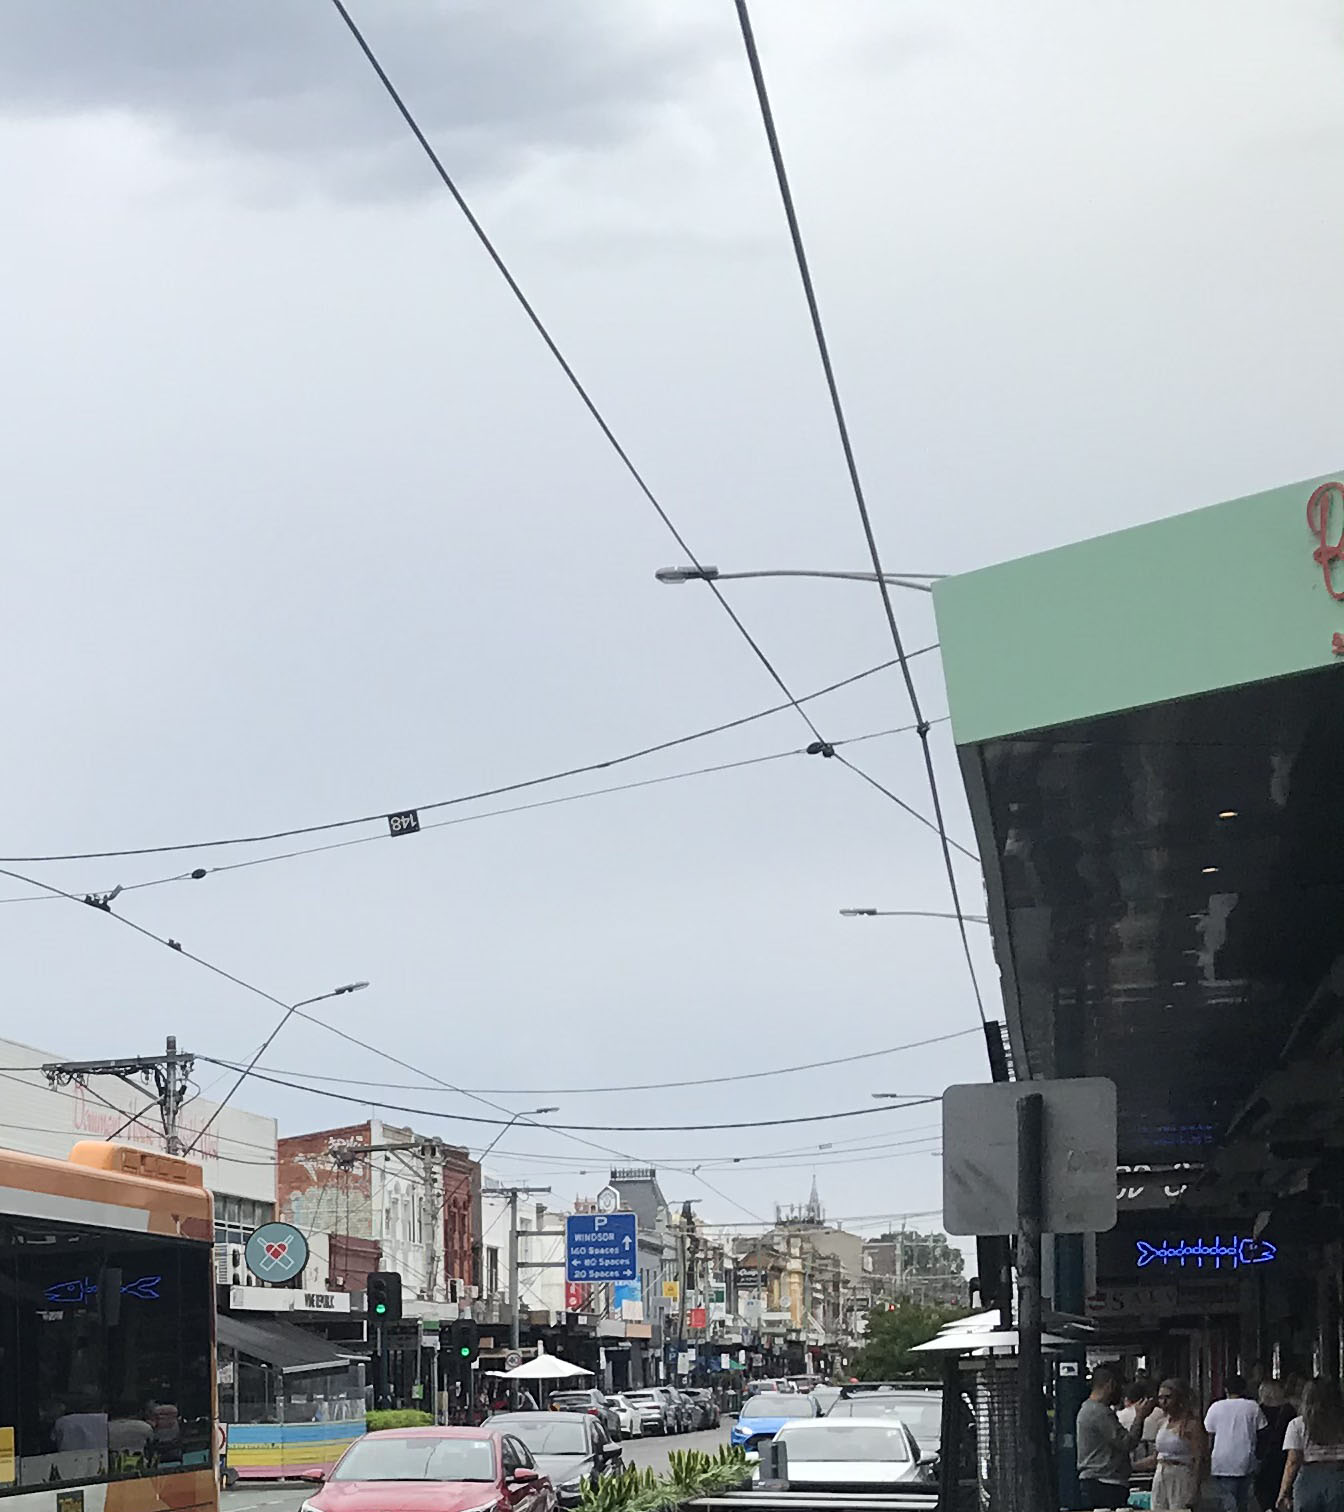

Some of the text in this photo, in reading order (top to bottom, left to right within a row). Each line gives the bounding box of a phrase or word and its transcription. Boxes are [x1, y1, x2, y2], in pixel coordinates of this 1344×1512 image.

[595, 1216, 608, 1231] P
[574, 1232, 615, 1242] WINDSOR
[588, 1246, 620, 1255] Spaces
[588, 1270, 620, 1279] Spaces
